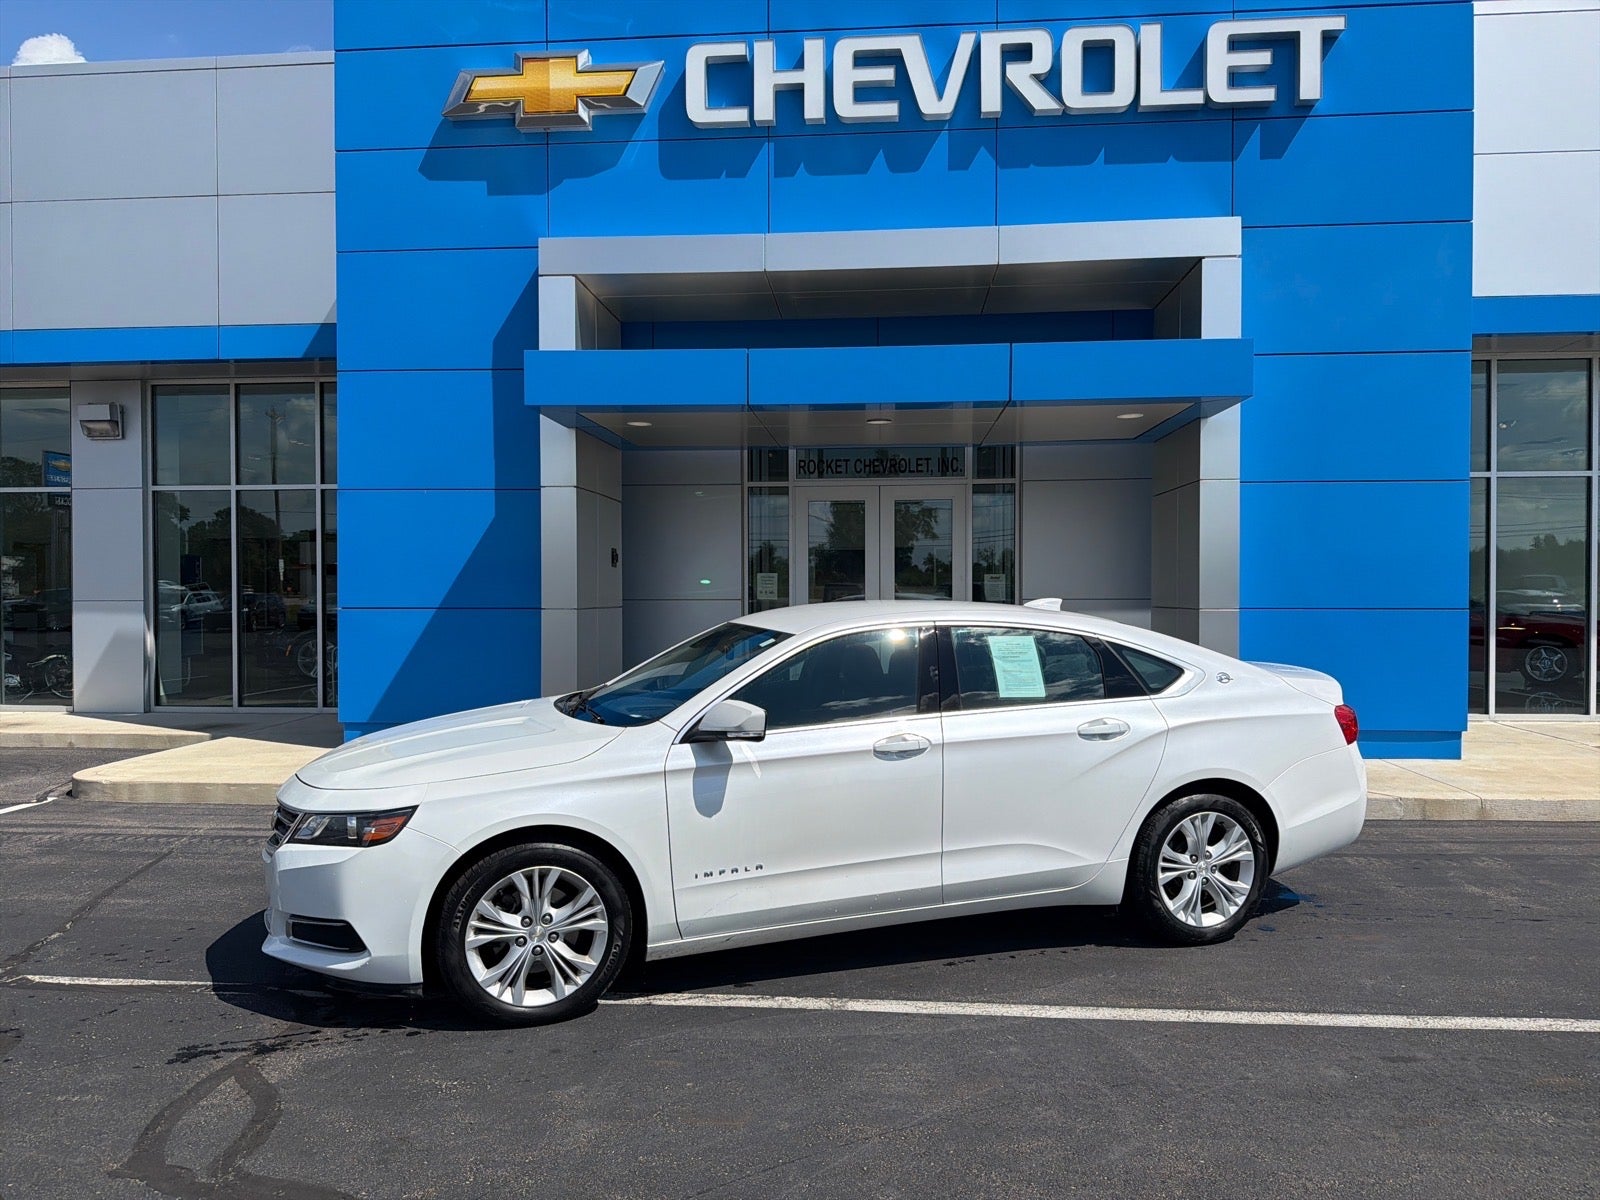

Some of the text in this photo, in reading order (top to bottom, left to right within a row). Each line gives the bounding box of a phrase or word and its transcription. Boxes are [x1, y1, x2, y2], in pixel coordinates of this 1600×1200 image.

[685, 15, 1347, 128] CHEVROLET
[798, 457, 963, 475] ROCKET CHEVROLET, INC.
[695, 864, 764, 879] IMPALA
